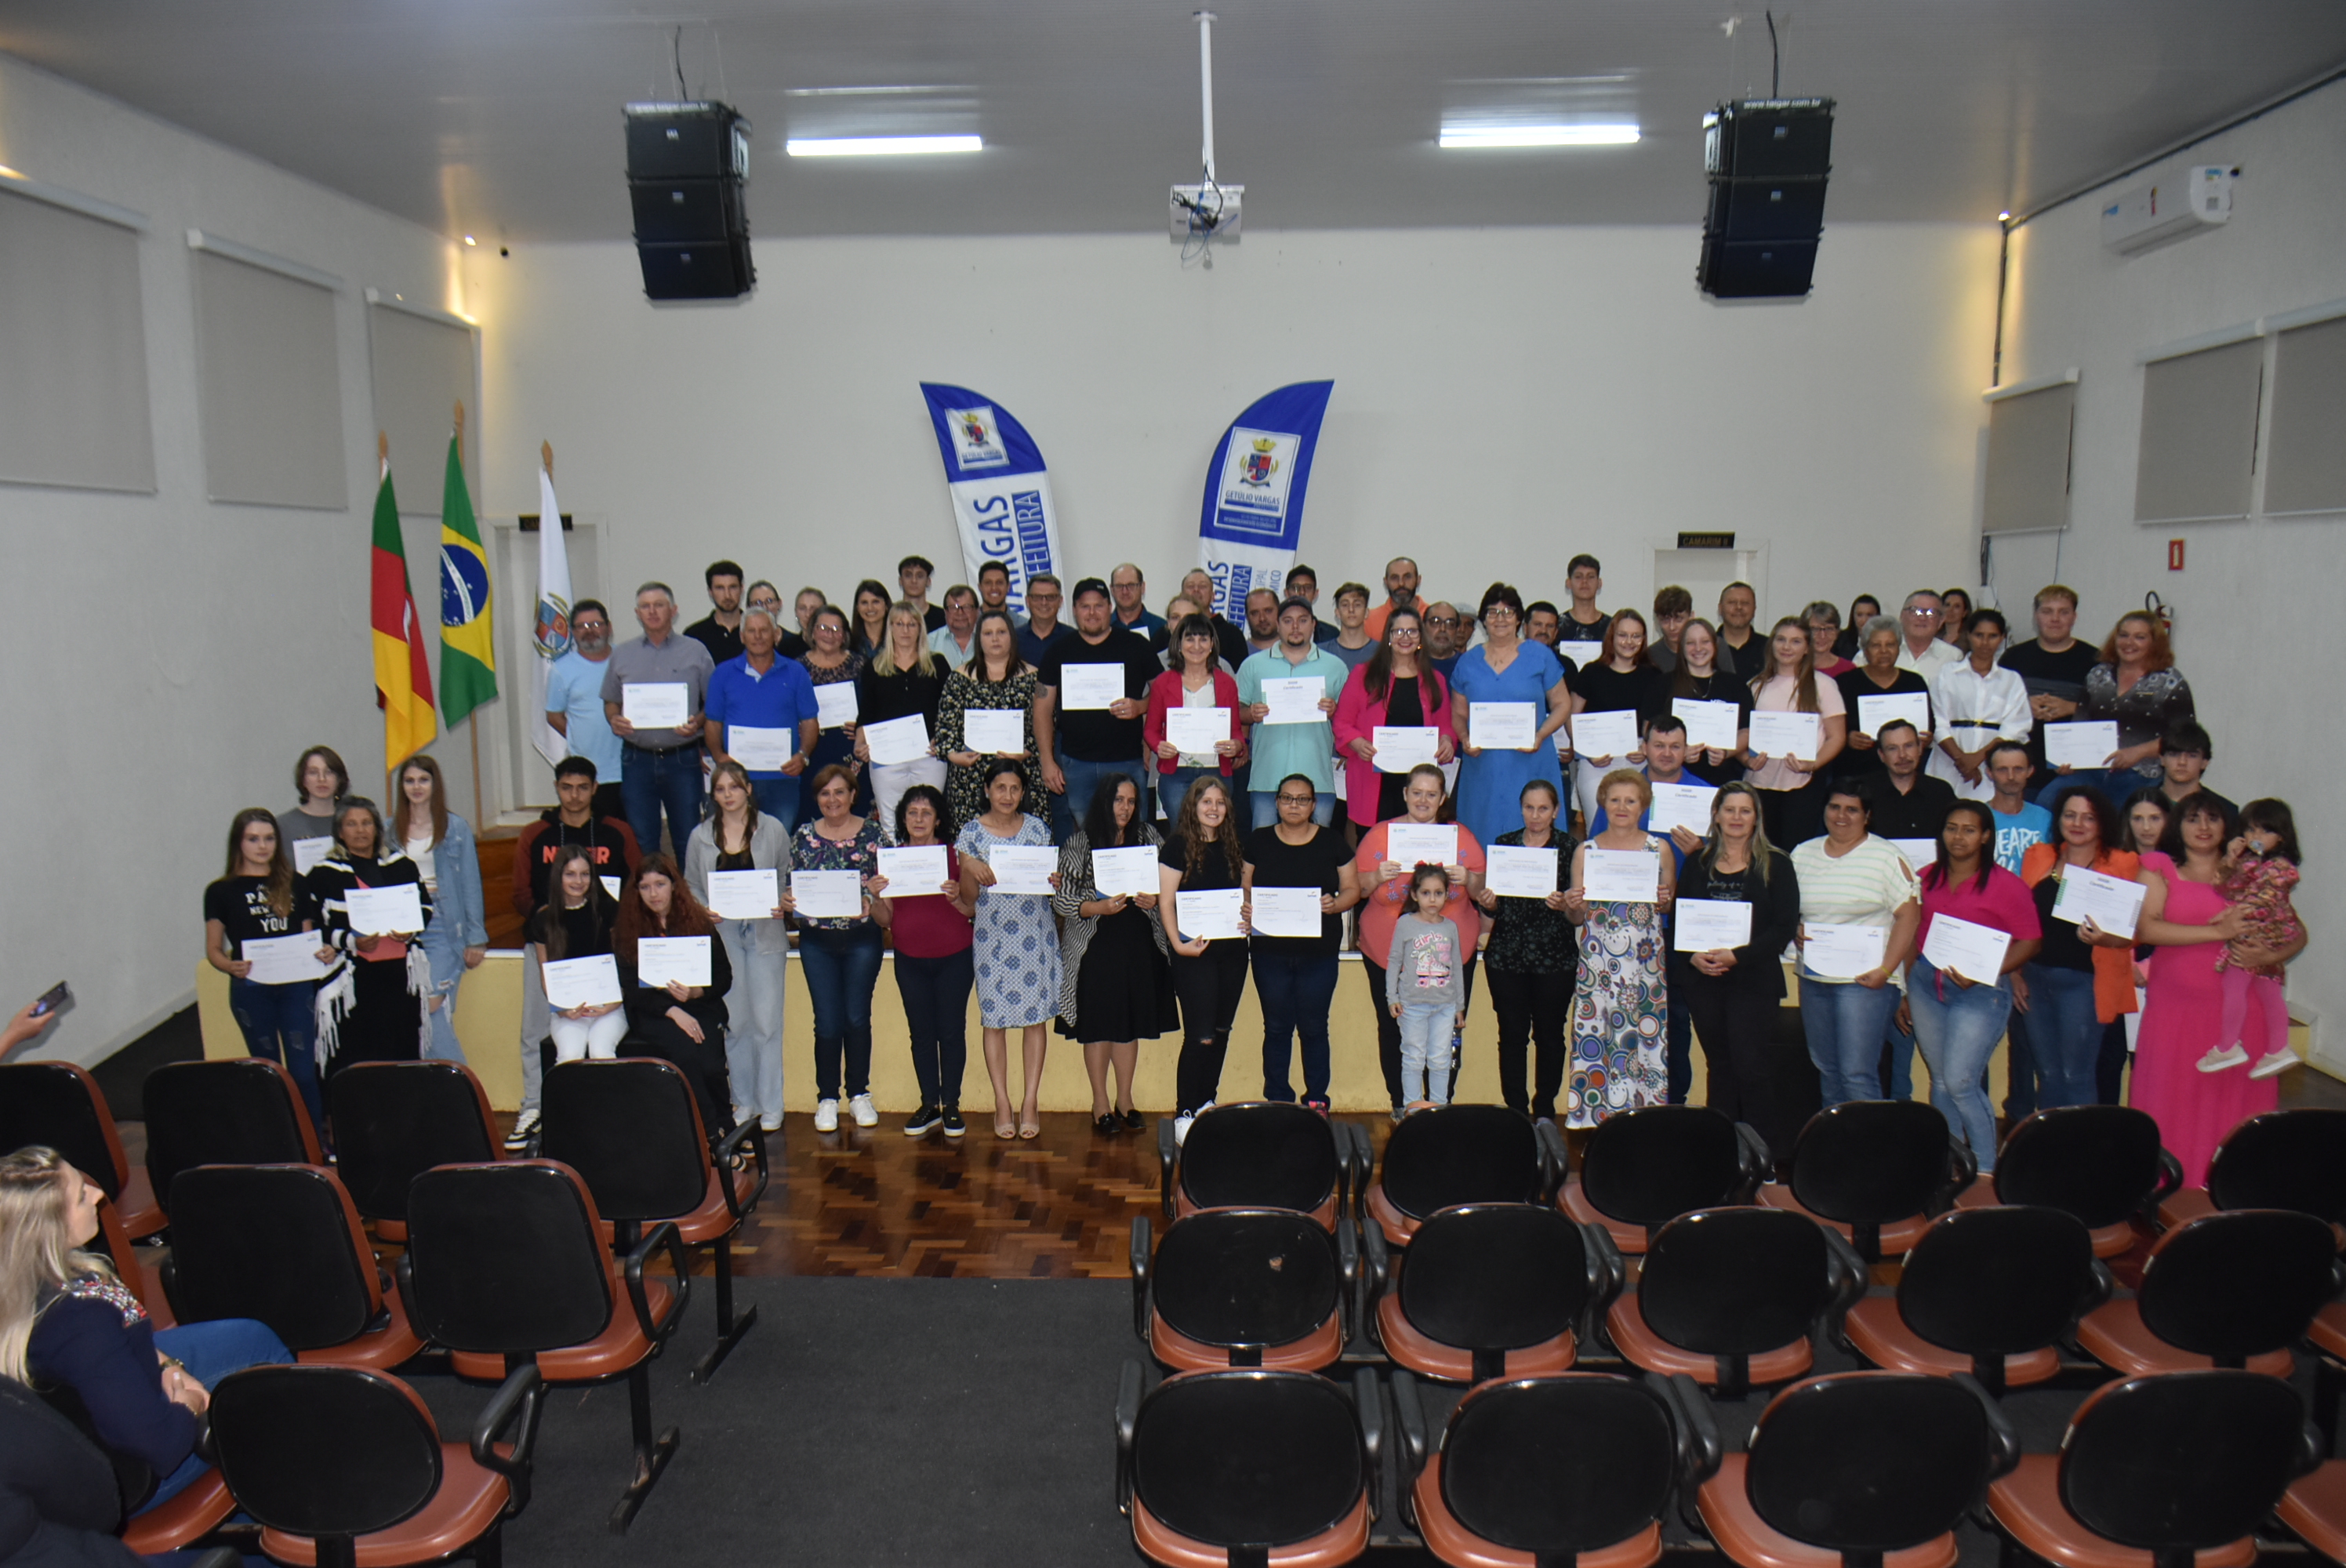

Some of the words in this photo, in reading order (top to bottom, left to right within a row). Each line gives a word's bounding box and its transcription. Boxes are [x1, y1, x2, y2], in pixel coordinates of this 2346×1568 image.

[1226, 490, 1253, 501] GETÚLIO
[1255, 493, 1280, 505] VARGAS
[1683, 537, 1722, 546] CAMARIM
[260, 916, 289, 933] YOU
[1413, 931, 1443, 949] Girls
